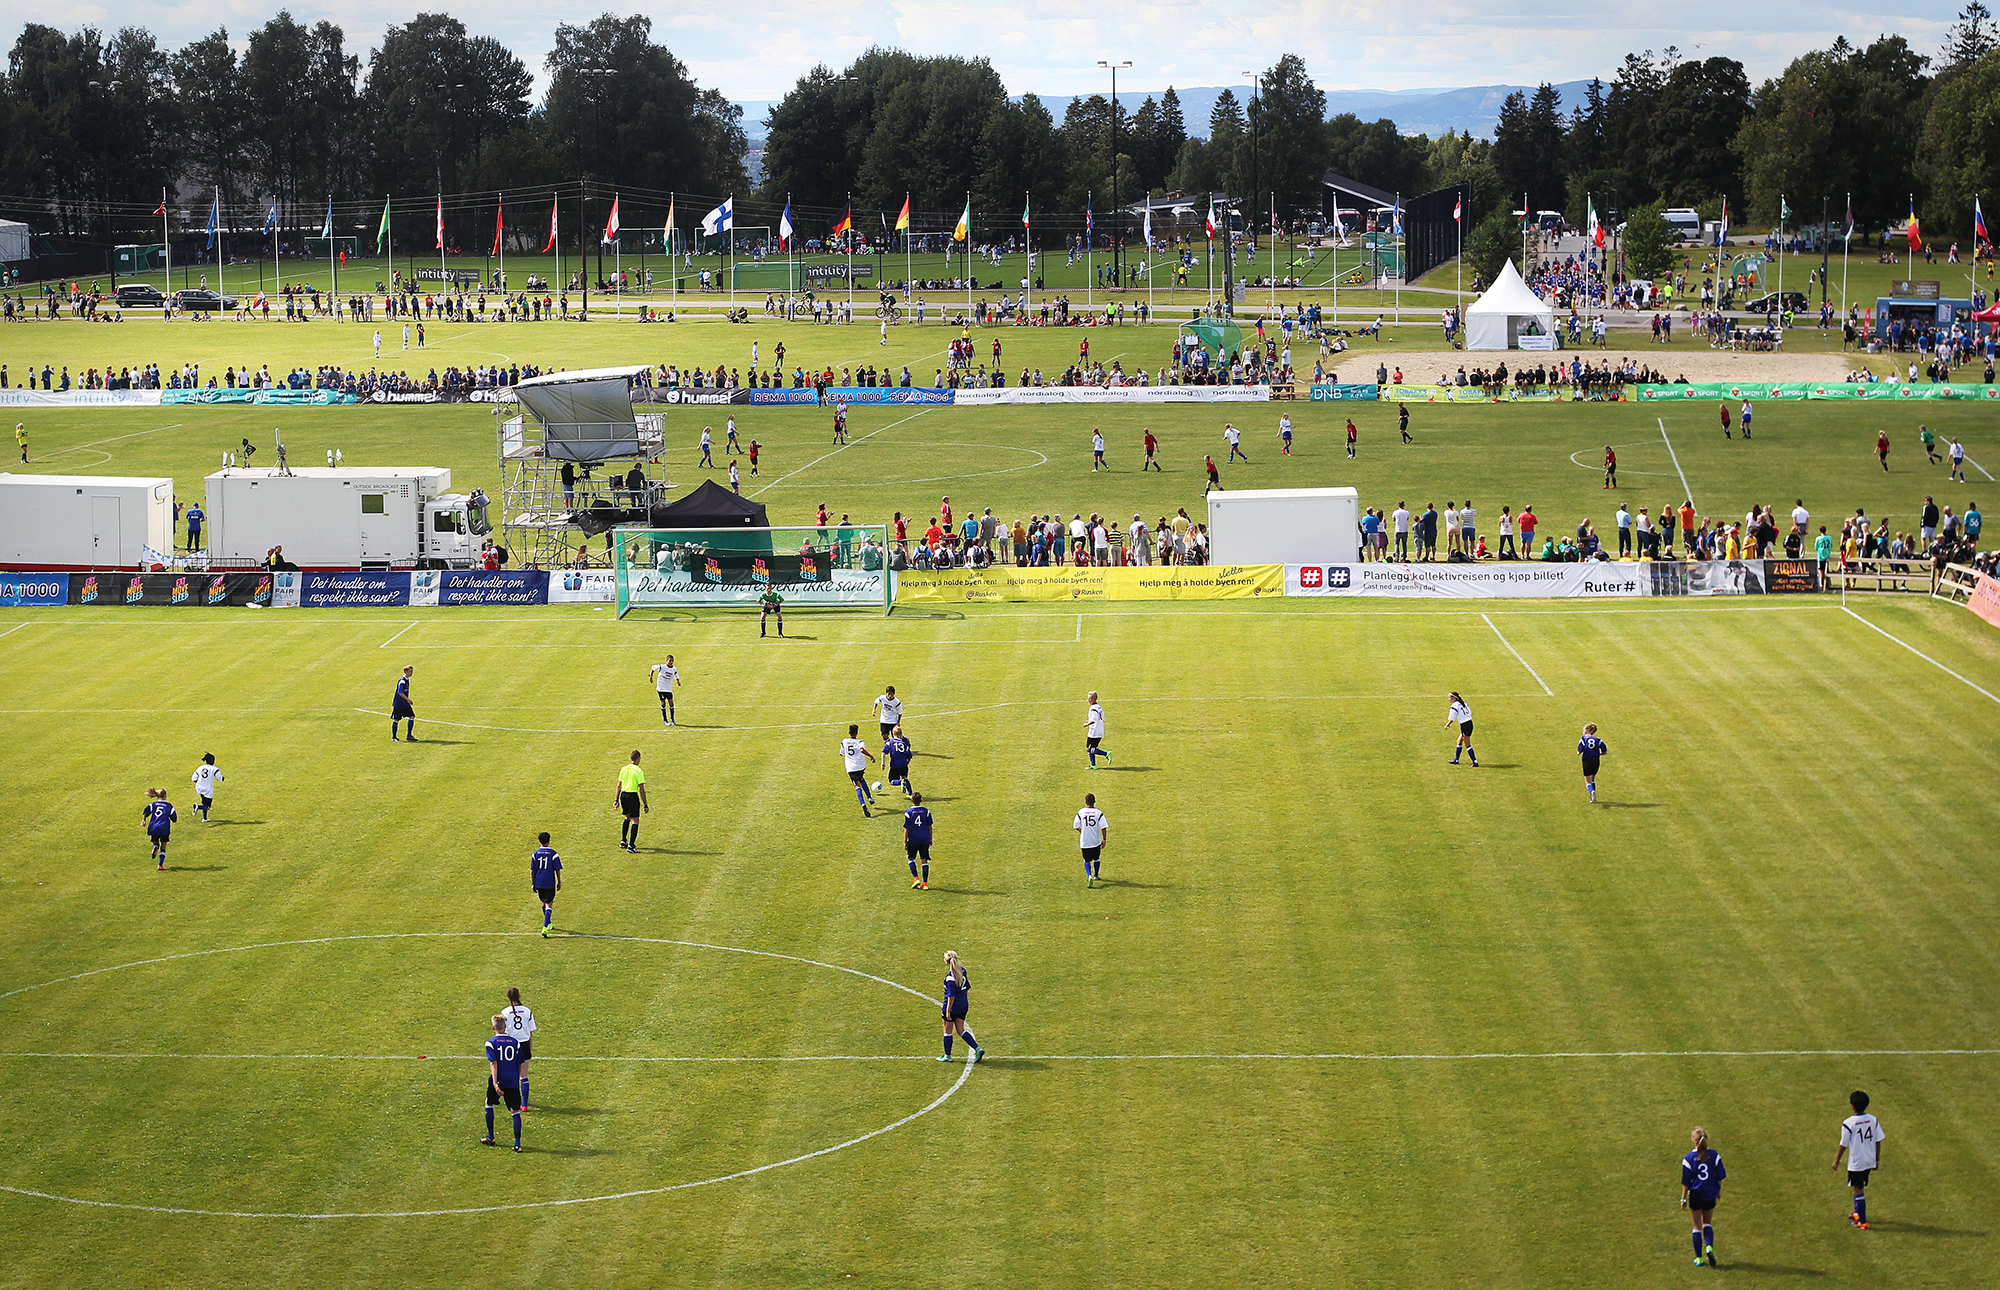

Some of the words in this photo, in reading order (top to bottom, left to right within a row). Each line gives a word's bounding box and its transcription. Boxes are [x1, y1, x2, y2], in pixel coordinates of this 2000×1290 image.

[418, 268, 456, 282] intility
[808, 265, 848, 278] intility
[74, 392, 126, 403] intility
[187, 388, 213, 404] DNB
[245, 388, 271, 405] DNB
[302, 389, 328, 405] DNB
[387, 390, 437, 402] hummel
[681, 392, 731, 404] hummel
[754, 393, 785, 403] REMA
[789, 392, 814, 402] 1000
[857, 392, 882, 402] 1000
[890, 392, 922, 403] REMA
[924, 392, 949, 403] 1000
[957, 391, 1001, 399] nordialog
[1020, 389, 1064, 398] nordialog
[1083, 389, 1128, 398] nordialog
[1147, 389, 1193, 397] nordialog
[1212, 389, 1258, 397] nordialog
[1314, 384, 1342, 401] DNB
[1970, 518, 1979, 526] 56
[1823, 540, 1830, 548] 12
[1218, 566, 1244, 579] sletta
[1364, 571, 1409, 583] Planlegg
[1413, 571, 1492, 581] kollektivreisen
[1493, 572, 1506, 583] og
[1508, 571, 1531, 583] kjøp
[1534, 571, 1564, 580] billett
[85, 576, 96, 587] EAT
[131, 576, 141, 586] EAT
[176, 576, 187, 587] EAT
[213, 575, 224, 587] EAT
[258, 576, 269, 586] EAT
[310, 576, 328, 589] Det
[327, 576, 368, 589] handler
[370, 581, 386, 589] om
[448, 576, 467, 588] Det
[466, 576, 507, 588] handler
[509, 580, 525, 588] om
[585, 575, 615, 583] FAIR
[637, 576, 659, 592] Det
[836, 575, 879, 592] sant?
[901, 580, 919, 589] Hjelp
[938, 578, 942, 586] å
[965, 579, 982, 588] byen
[1007, 578, 1025, 586] Hjelp
[1027, 579, 1042, 587] meg
[1071, 577, 1087, 586] byen
[1139, 579, 1161, 588] Hjelp
[1163, 580, 1182, 588] meg
[1183, 578, 1188, 586] å
[1216, 578, 1236, 587] byen
[19, 582, 60, 598] 1000
[81, 583, 98, 596] MOVE
[126, 583, 144, 596] MOVE
[172, 583, 189, 596] MOVE
[208, 583, 226, 596] MOVE
[254, 581, 271, 595] MOVE
[81, 592, 98, 604] SLEEP
[126, 592, 144, 604] SLEEP
[171, 592, 189, 604] SLEEP
[208, 593, 226, 604] SLEEP
[253, 592, 270, 603] SLEEP
[309, 591, 344, 606] respekt,
[347, 591, 368, 603] ikke
[368, 590, 400, 602] sant?
[448, 590, 483, 605] respekt,
[485, 590, 506, 602] ikke
[507, 589, 538, 602] sant?
[893, 742, 905, 752] 13
[1588, 738, 1595, 749] 8
[848, 746, 855, 756] 5
[202, 768, 208, 778] 3
[154, 806, 163, 817] 5
[914, 815, 922, 826] 4
[1083, 815, 1096, 826] 15
[538, 856, 548, 869] 11
[514, 1016, 523, 1030] 8
[497, 1045, 514, 1061] 10
[1857, 1126, 1873, 1144] 14
[1697, 1163, 1709, 1181] 3
